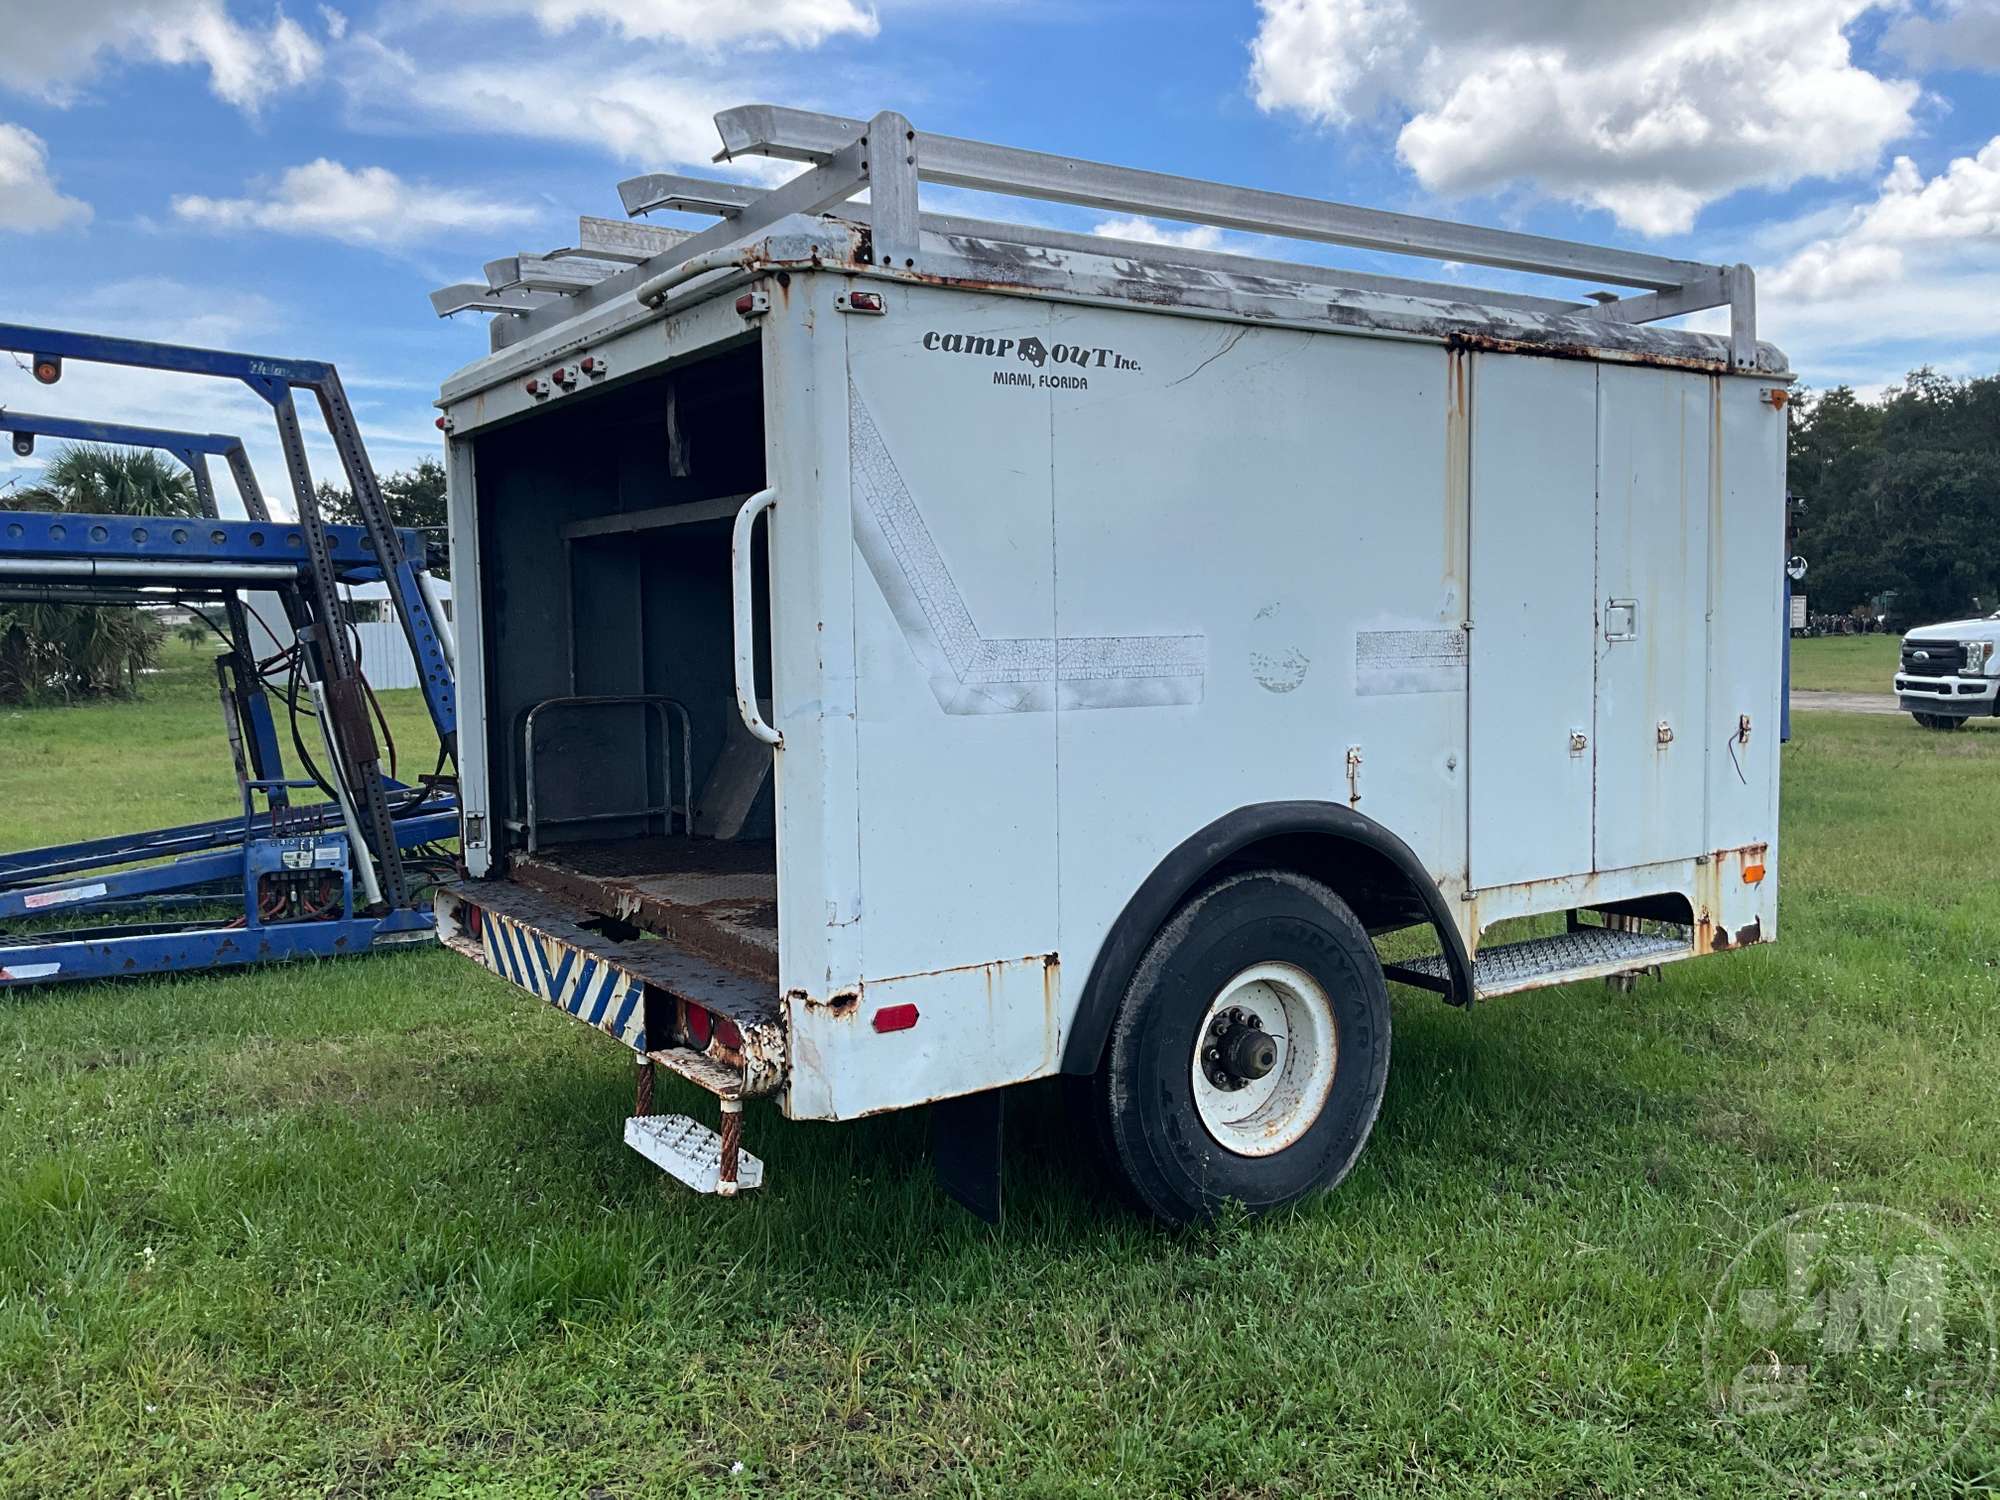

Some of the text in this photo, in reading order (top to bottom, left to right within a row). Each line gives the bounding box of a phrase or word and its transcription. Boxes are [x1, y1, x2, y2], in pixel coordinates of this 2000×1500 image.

[1114, 354, 1142, 371] Inc.
[993, 371, 1088, 390] MIAMI, FLORIDA
